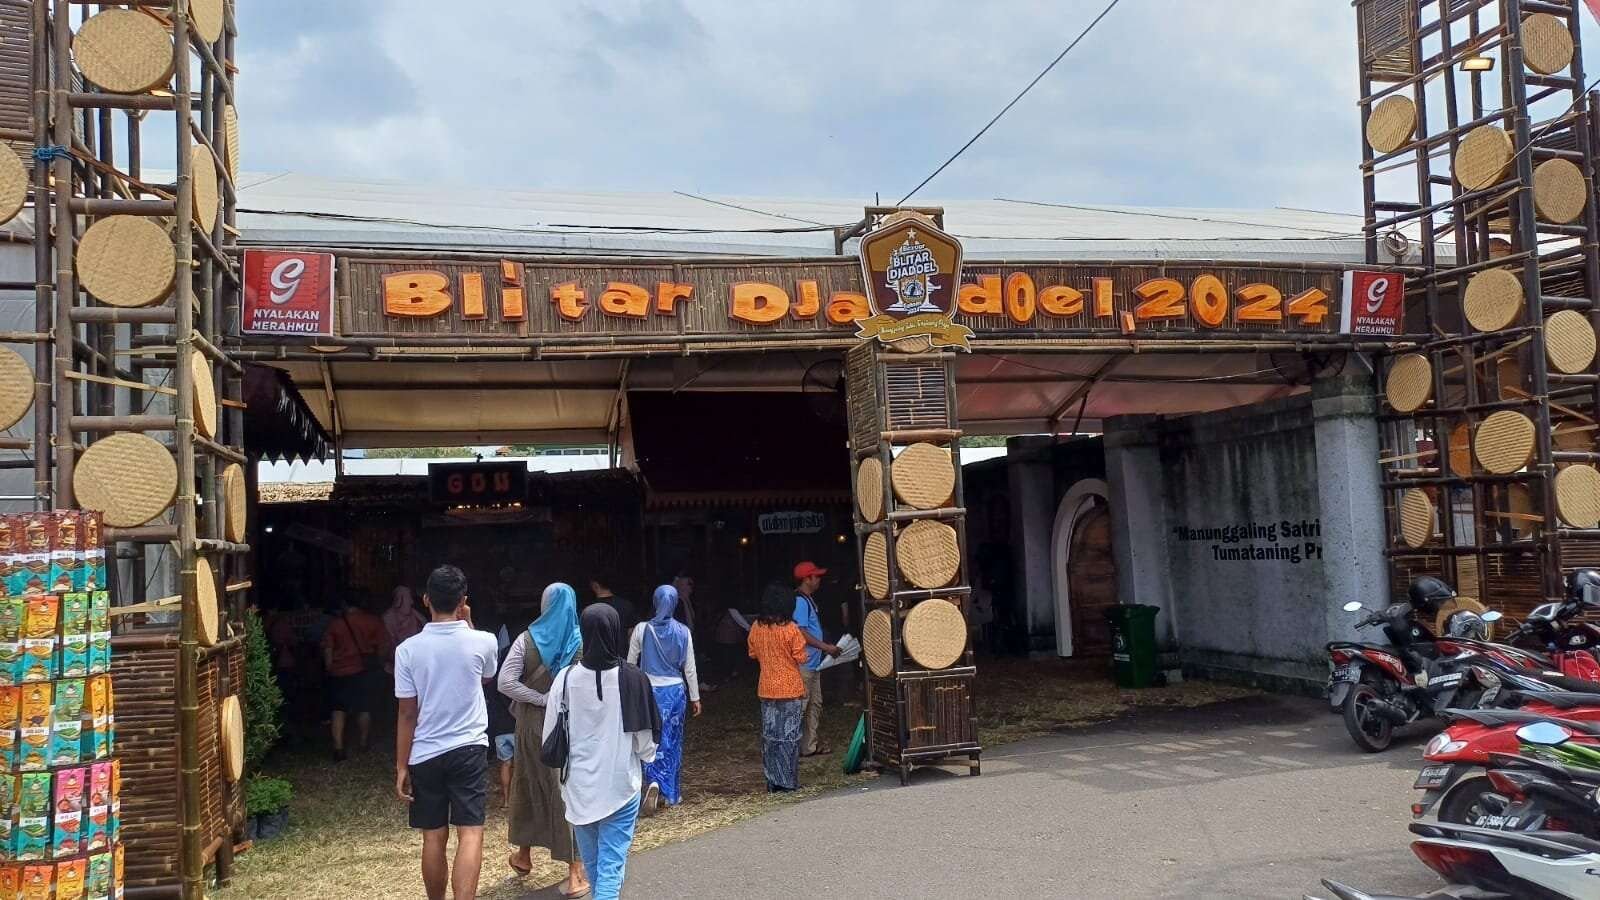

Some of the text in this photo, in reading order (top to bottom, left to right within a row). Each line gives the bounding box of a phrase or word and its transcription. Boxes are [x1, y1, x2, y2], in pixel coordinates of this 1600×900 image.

[893, 252, 929, 268] BLITAR
[889, 261, 936, 280] DJADOEL
[379, 259, 695, 321] Blitar
[253, 309, 320, 320] NYALAKAN
[1356, 317, 1395, 325] NYALAKAN
[251, 321, 319, 332] MERAHMU!
[1355, 325, 1395, 335] MERAHMU!
[1212, 543, 1301, 563] Tumataning
